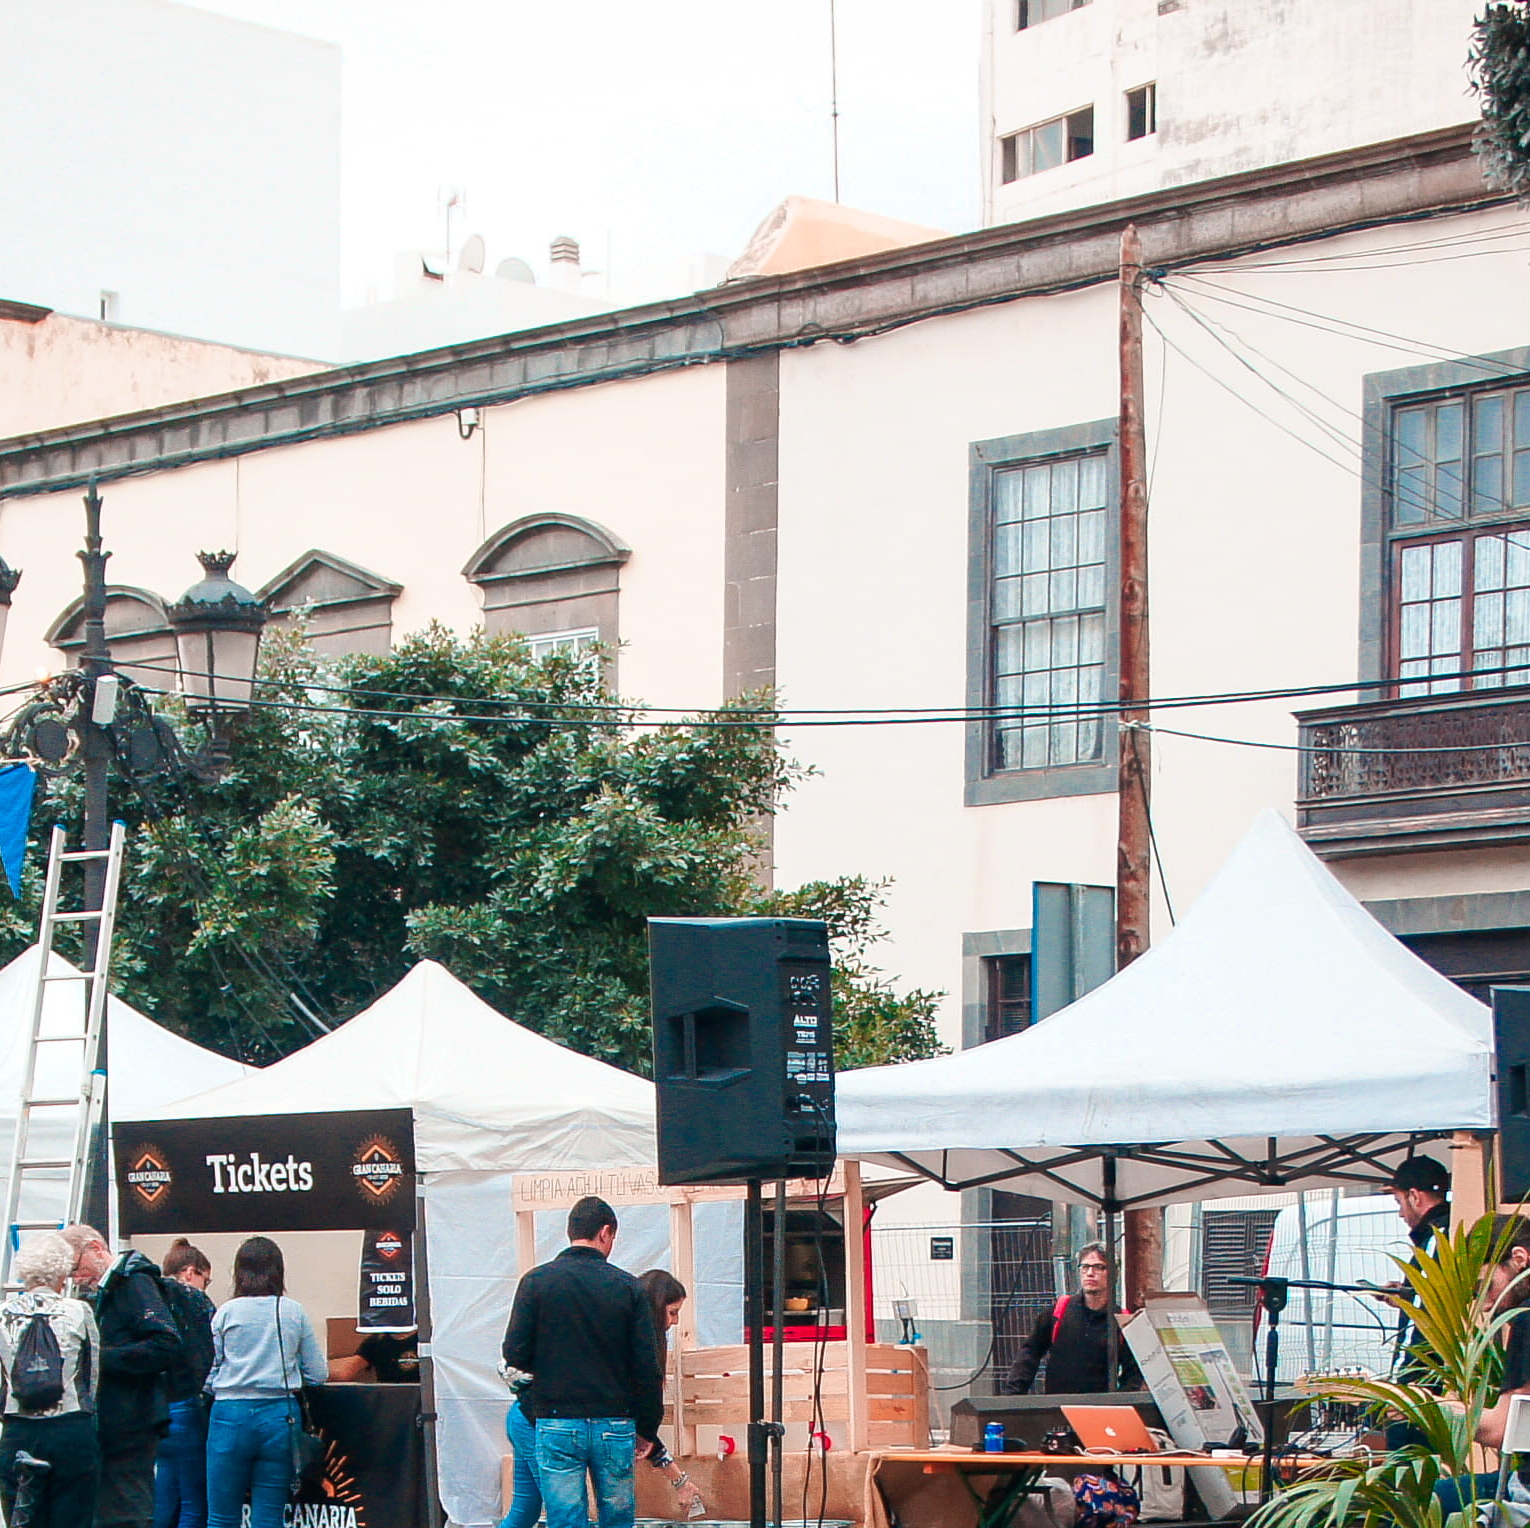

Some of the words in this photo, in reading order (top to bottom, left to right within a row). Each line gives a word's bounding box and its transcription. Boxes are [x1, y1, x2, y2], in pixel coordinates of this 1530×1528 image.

[206, 1152, 314, 1194] Tickets
[521, 1178, 563, 1201] LIMPIA
[370, 1272, 406, 1283] TICKETS
[376, 1284, 402, 1295] SOLO
[369, 1296, 408, 1307] BEBIDAS
